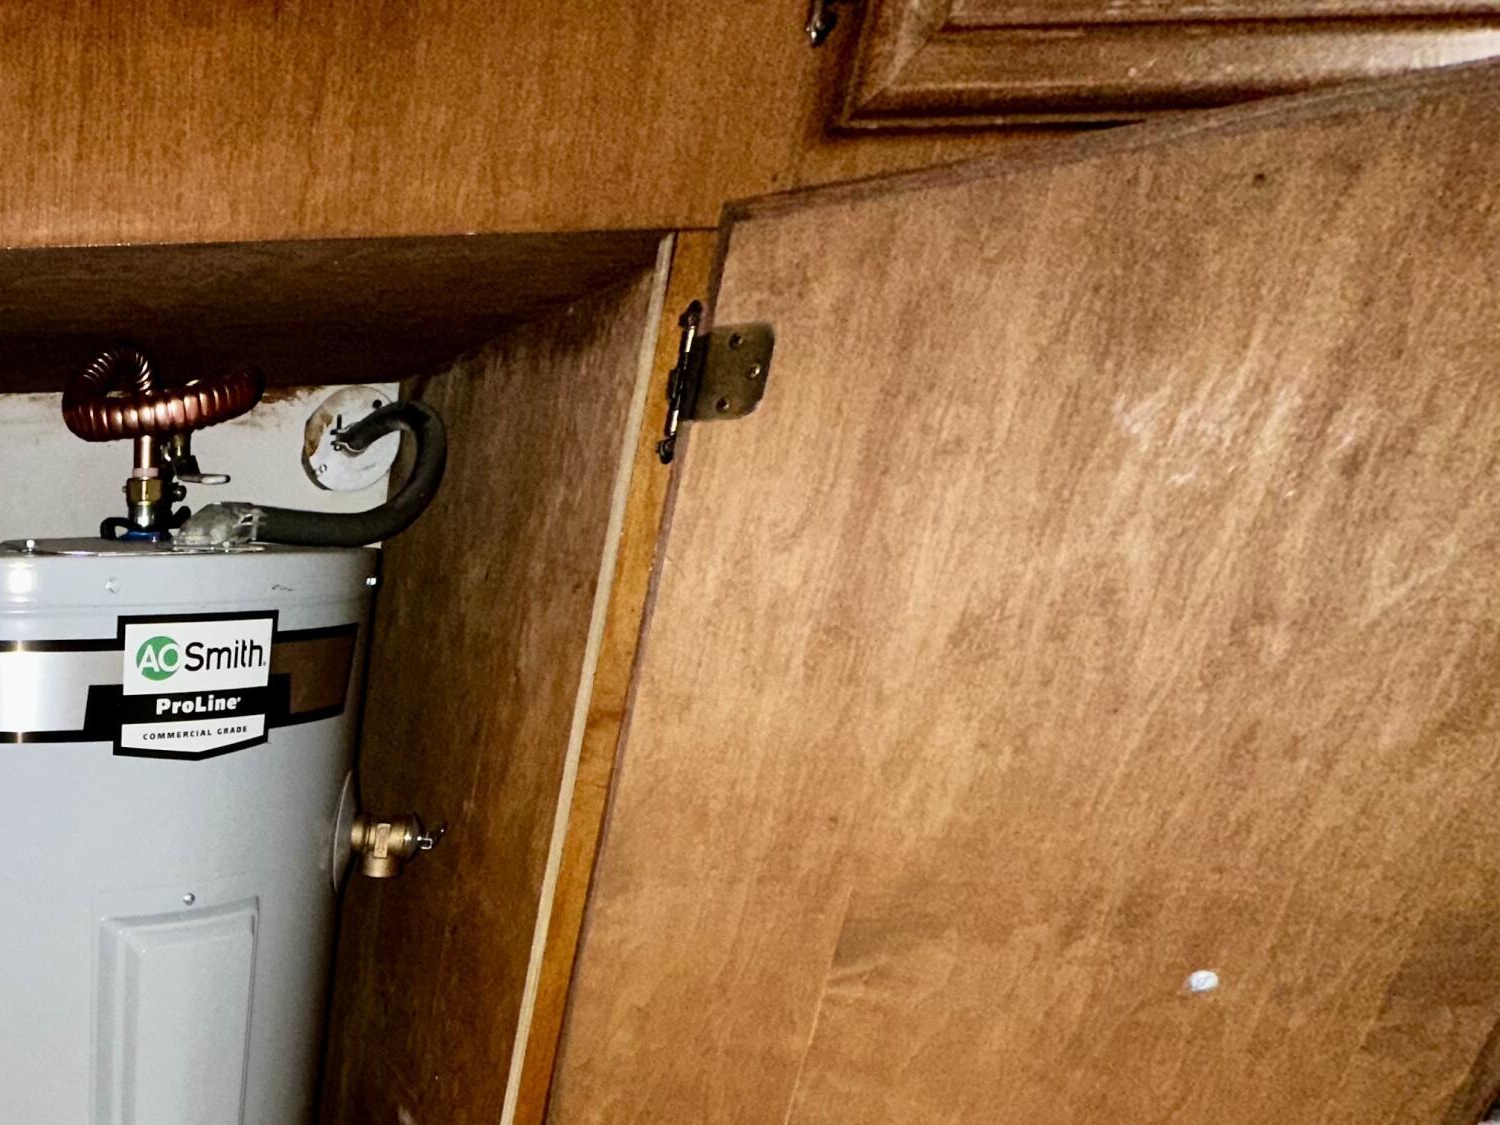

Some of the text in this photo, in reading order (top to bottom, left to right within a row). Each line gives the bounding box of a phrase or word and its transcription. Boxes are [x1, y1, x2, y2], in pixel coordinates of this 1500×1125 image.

[184, 639, 263, 671] Smith
[156, 695, 241, 715] ProLine
[142, 726, 248, 741] COMMERCIAL GRADE
